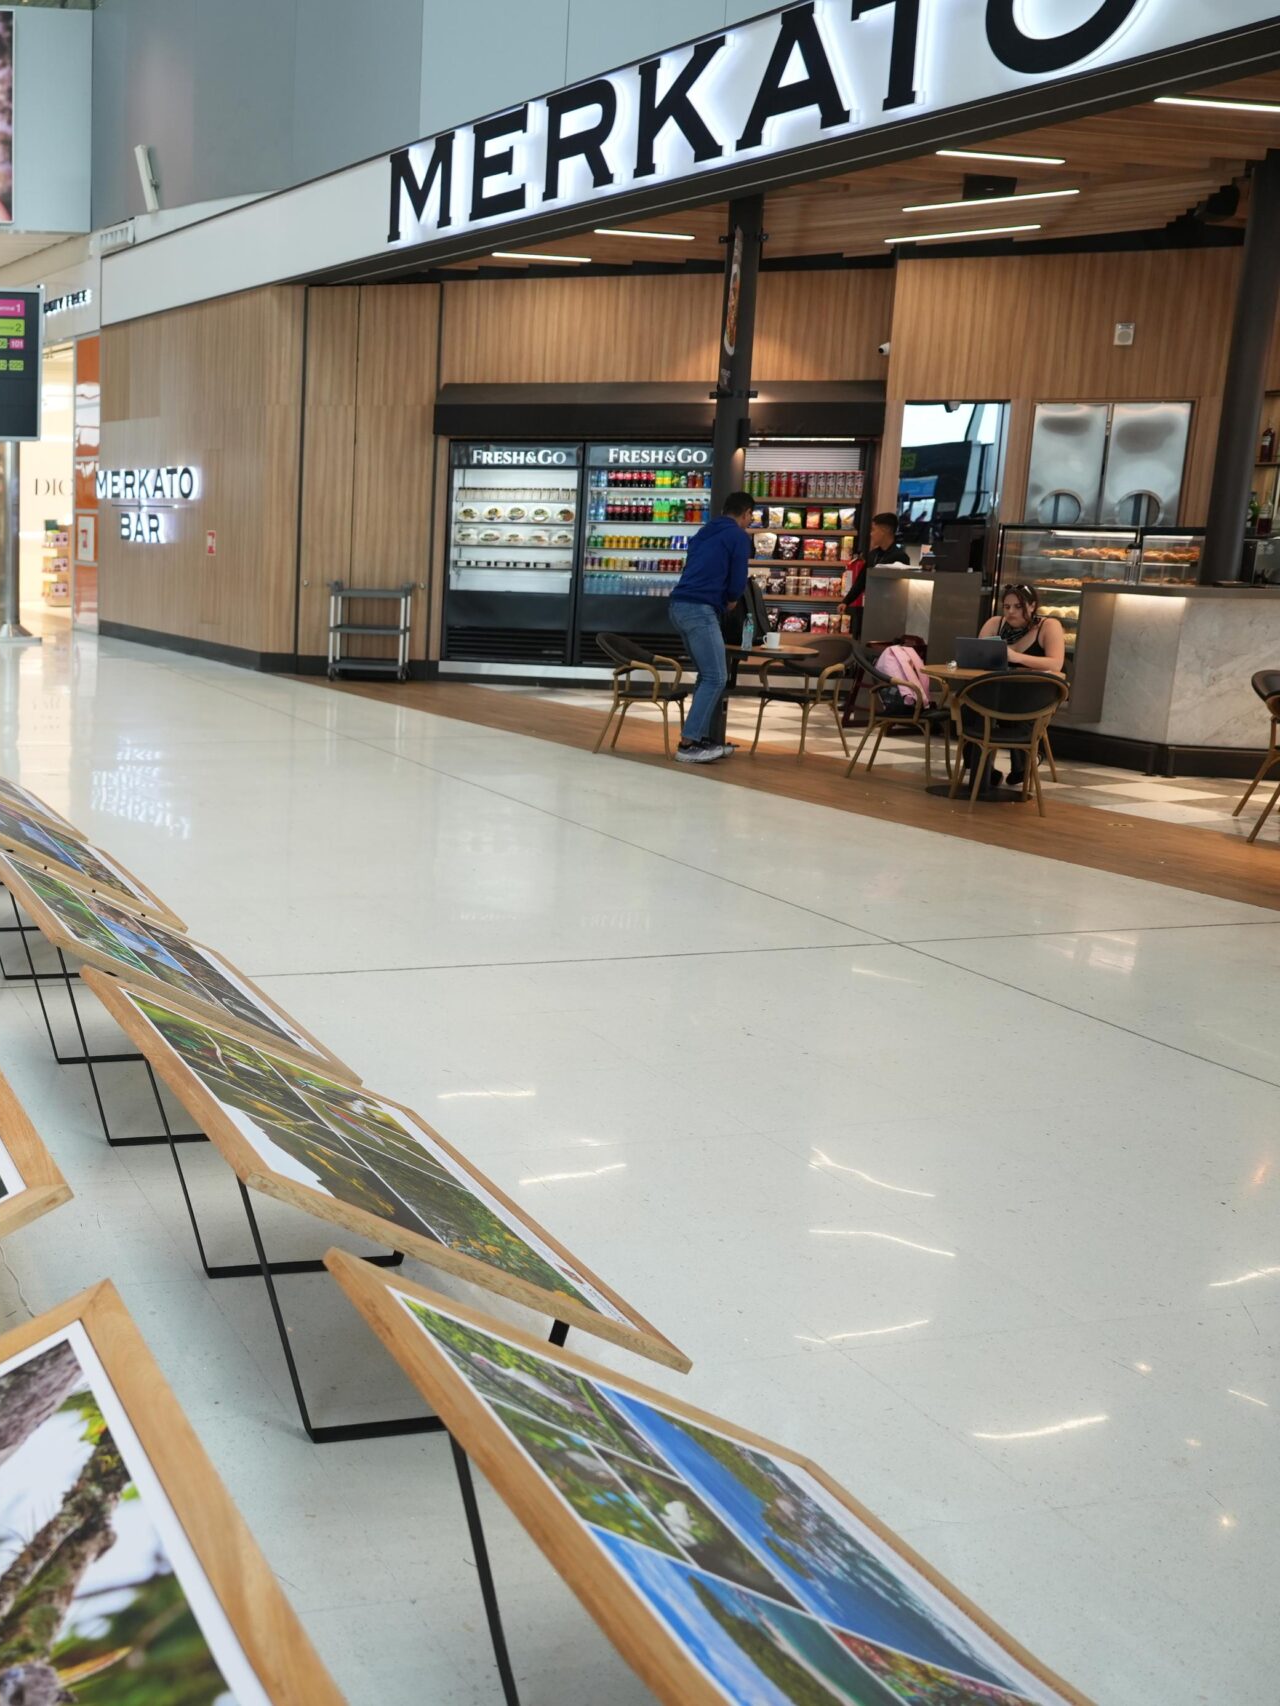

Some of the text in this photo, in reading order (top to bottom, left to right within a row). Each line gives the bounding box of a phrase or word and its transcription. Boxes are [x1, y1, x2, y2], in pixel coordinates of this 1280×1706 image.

[16, 304, 21, 312] 1
[15, 323, 22, 332] 2
[472, 449, 567, 465] FRESH&GO
[608, 448, 708, 464] FRESH&GO
[95, 467, 195, 499] MERKATO
[120, 513, 164, 543] BAR
